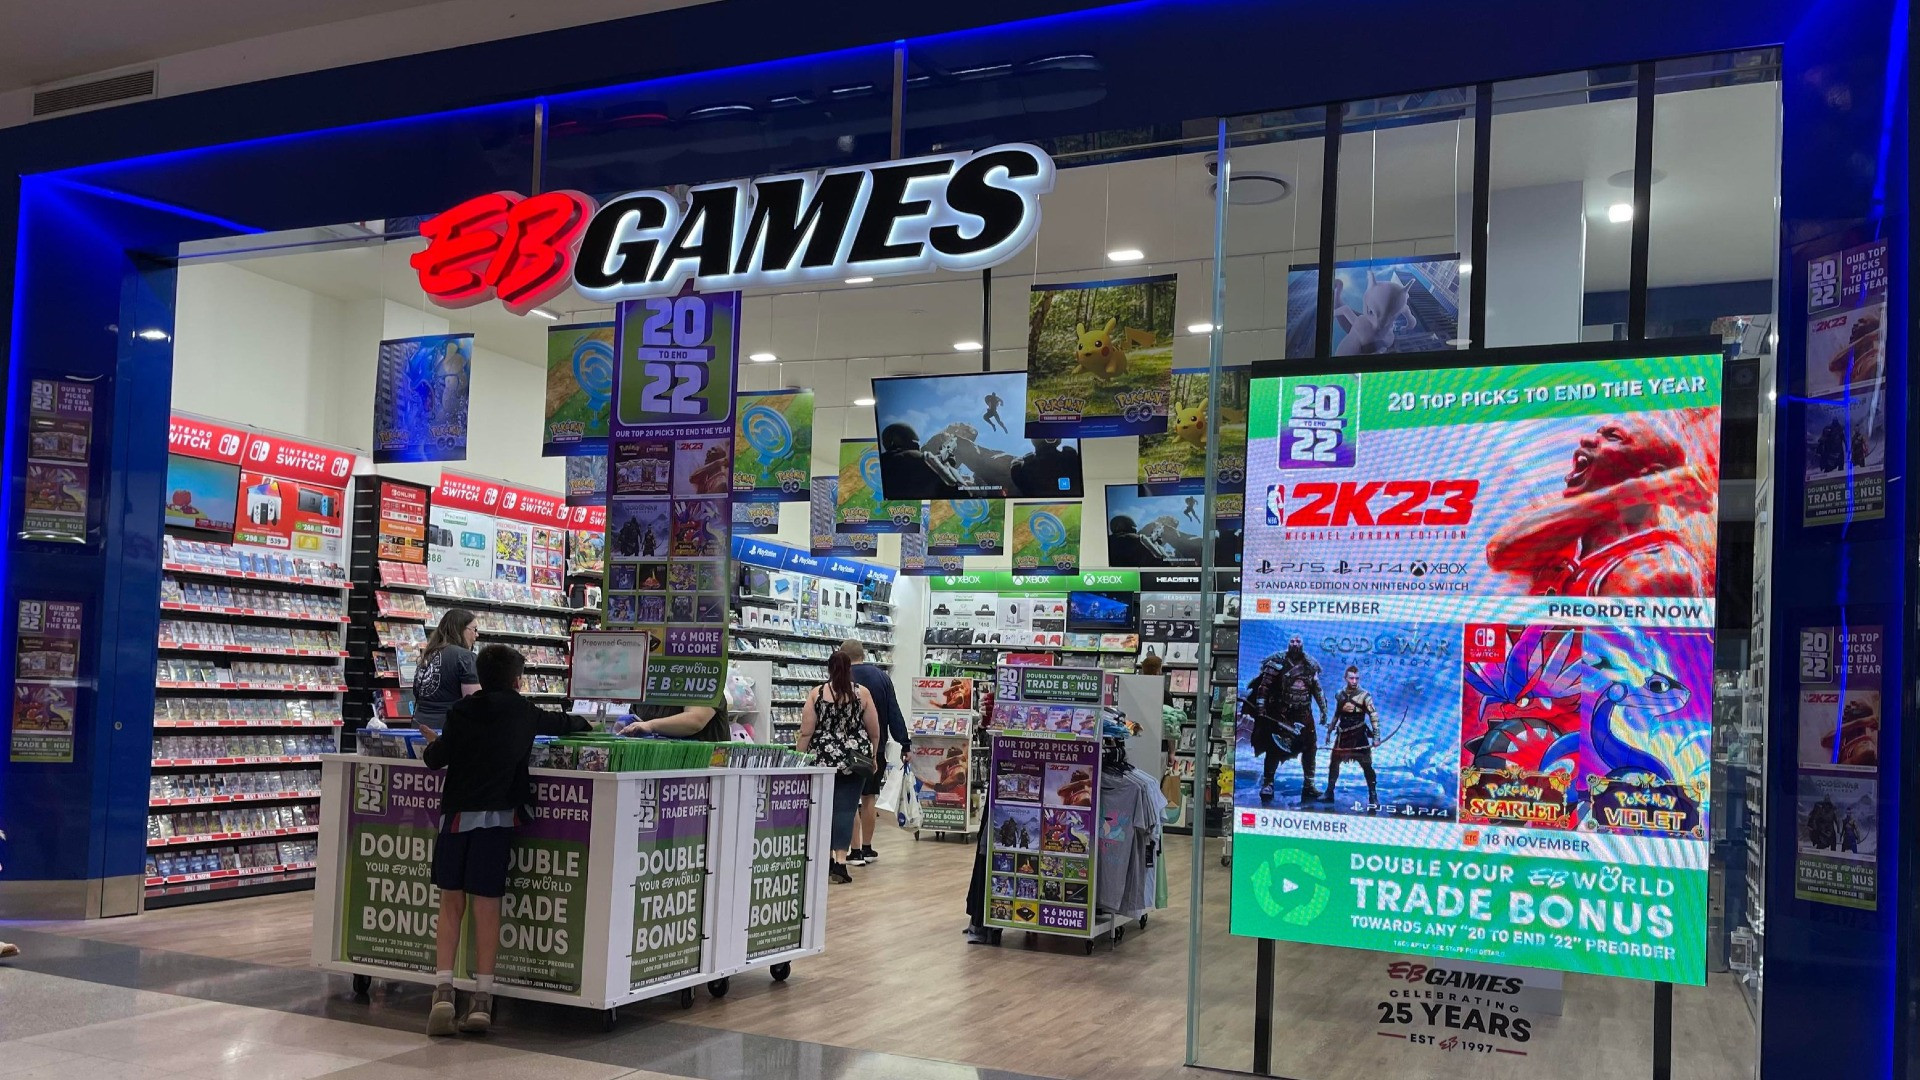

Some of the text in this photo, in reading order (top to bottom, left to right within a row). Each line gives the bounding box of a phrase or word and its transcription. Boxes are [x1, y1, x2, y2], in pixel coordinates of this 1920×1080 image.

[411, 147, 1050, 311] EB GAMES
[1847, 247, 1886, 264] OUR TOP
[1811, 260, 1835, 282] 20
[1853, 259, 1880, 273] PICKS
[1850, 268, 1884, 284] TO END
[1843, 277, 1888, 296] THE YEAR
[1811, 286, 1834, 306] 22
[643, 296, 706, 347] 20
[659, 351, 688, 359] TO END
[641, 363, 702, 415] 22
[1388, 376, 1706, 412] 20 TOP PICKS TO END THE YEAR
[1292, 385, 1343, 419] 20
[616, 430, 629, 438] OUR
[632, 430, 644, 438] TOP
[655, 429, 674, 437] PICKS
[686, 428, 699, 436] END
[714, 427, 730, 435] YEAR
[1291, 429, 1340, 462] 22
[279, 446, 326, 462] NINTENDO
[276, 454, 324, 472] SWITCH
[442, 487, 479, 501] SWITCH
[444, 480, 480, 492] NINTENDO
[520, 503, 553, 516] SWITCH
[523, 497, 554, 507] NINTENDO
[1286, 479, 1480, 526] 2K23
[1285, 531, 1467, 541] MICHAEL JORDAN EDITION
[757, 548, 776, 557] PlayStation
[799, 556, 818, 566] PlayStation
[1280, 562, 1467, 574] PS5 PS4 XBOX
[1255, 581, 1469, 591] STANDARD EDITION ON NINTENDO SWITCH
[1277, 601, 1380, 614] 9 SEPTEMBER
[1549, 604, 1703, 619] PREORDER NOW
[582, 639, 616, 648] Preowned
[681, 631, 719, 642] 6 MORE
[1803, 633, 1827, 651] 20
[1861, 633, 1879, 642] TOP
[672, 643, 717, 654] TO COME
[1320, 637, 1373, 656] GOD
[1396, 638, 1450, 658] WAR
[1857, 655, 1876, 663] END
[685, 662, 719, 674] WORLD
[1000, 669, 1018, 682] 20
[1802, 658, 1825, 678] 22
[1856, 665, 1881, 674] YEAR
[918, 680, 944, 688] 2K23
[1026, 680, 1058, 689] TRADE
[999, 686, 1016, 699] 22
[999, 739, 1094, 753] OUR TOP 20 PICKS TO
[1012, 750, 1078, 761] END THE YEAR
[358, 763, 383, 785] 20
[358, 789, 380, 812] 22
[392, 795, 424, 808] TRADE
[772, 801, 791, 810] TRADE
[553, 809, 588, 822] OFFER
[662, 806, 687, 819] TRADE
[1367, 803, 1448, 817] PS5 PS4
[1470, 799, 1561, 822] SCARLET
[1604, 807, 1686, 829] VIOLET
[1261, 816, 1348, 833] 9 NOVEMBER
[753, 834, 805, 860] DOUBLE
[1485, 834, 1590, 852] 18 NOVEMBER
[366, 862, 389, 874] YOUR
[637, 845, 705, 877] DOUBLE
[754, 857, 801, 874] YOUR WORLD
[640, 872, 700, 891] YOUR WORLD
[1350, 853, 1674, 897] DOUBLE YOUR EB WORLD
[532, 876, 572, 892] WORLD
[754, 873, 799, 900] TRADE
[367, 877, 441, 908] TRADE
[641, 889, 697, 922] TRADE
[751, 899, 798, 928] BONUS
[1051, 908, 1084, 919] 6 MORE
[1350, 877, 1674, 939] TRADE BONUS
[1044, 916, 1082, 927] TO COME
[636, 918, 697, 953] BONUS
[1350, 914, 1422, 934] TOWARDS
[1425, 923, 1457, 937] ANY
[1489, 929, 1509, 943] TO
[1513, 931, 1546, 945] END
[1586, 939, 1675, 960] PREORDER
[1388, 962, 1523, 994] EB GAMES
[1390, 990, 1519, 1013] CELEBRATING
[1378, 1002, 1532, 1042] 25 YEARS
[1411, 1033, 1435, 1045] EST
[1462, 1041, 1493, 1053] 1997
